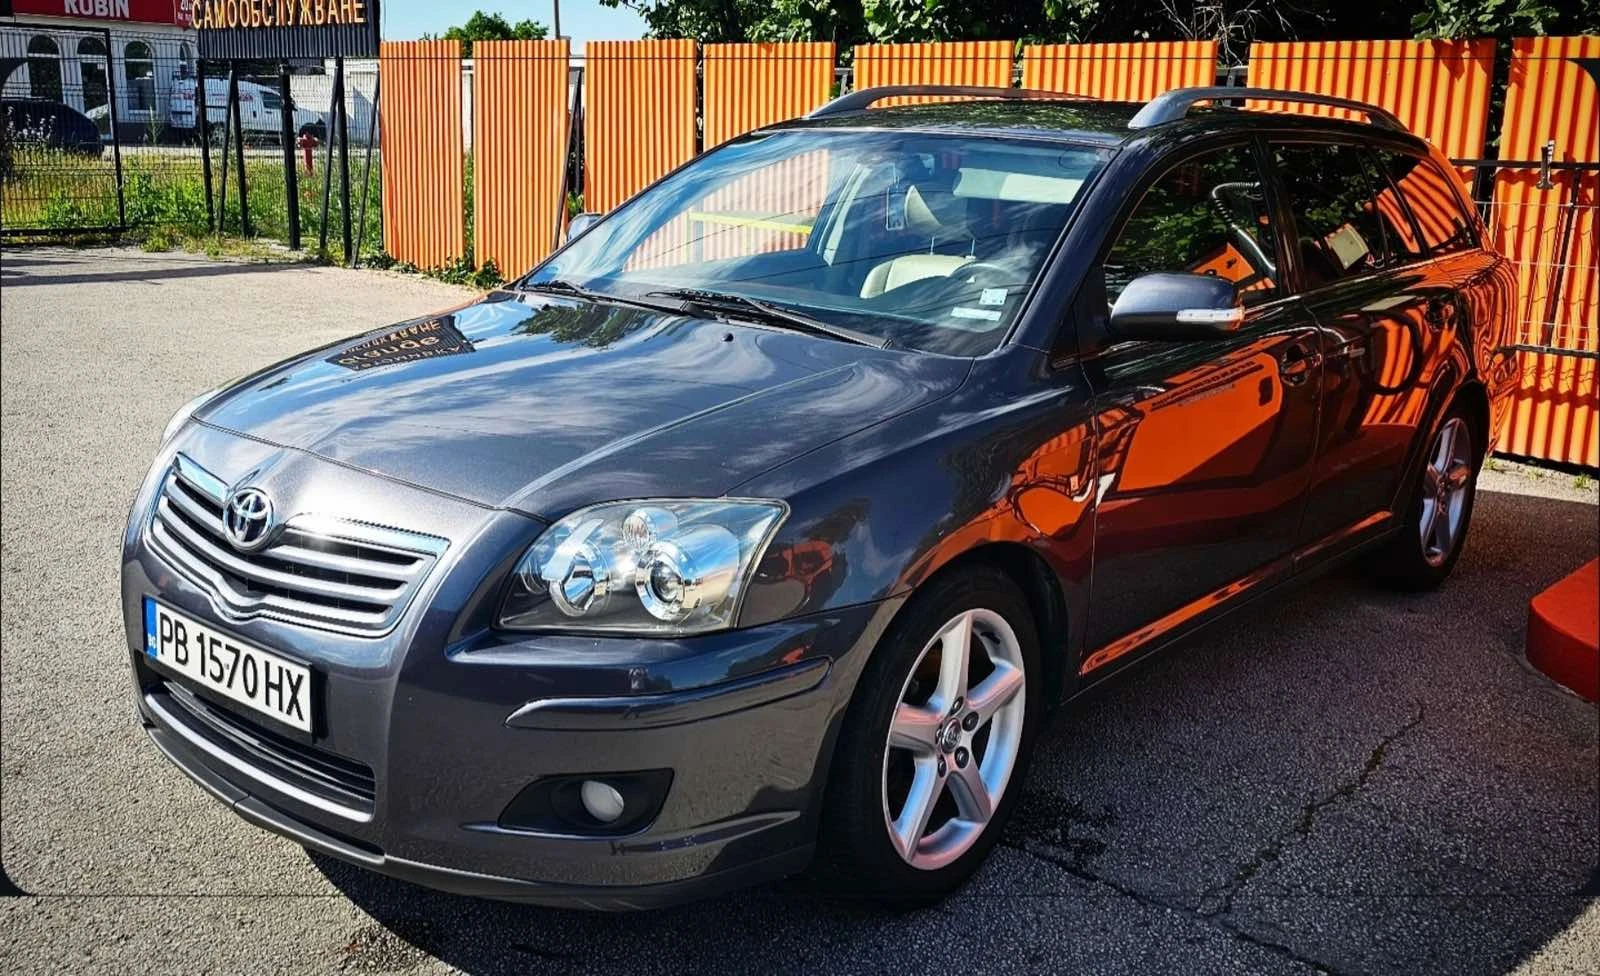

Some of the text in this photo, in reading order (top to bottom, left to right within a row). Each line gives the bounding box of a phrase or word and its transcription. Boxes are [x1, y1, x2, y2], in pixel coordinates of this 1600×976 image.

[64, 0, 130, 18] RUBIN
[192, 0, 366, 29] САМООБСЛУЖВАНЕ
[159, 612, 305, 722] PB 1570 HX
